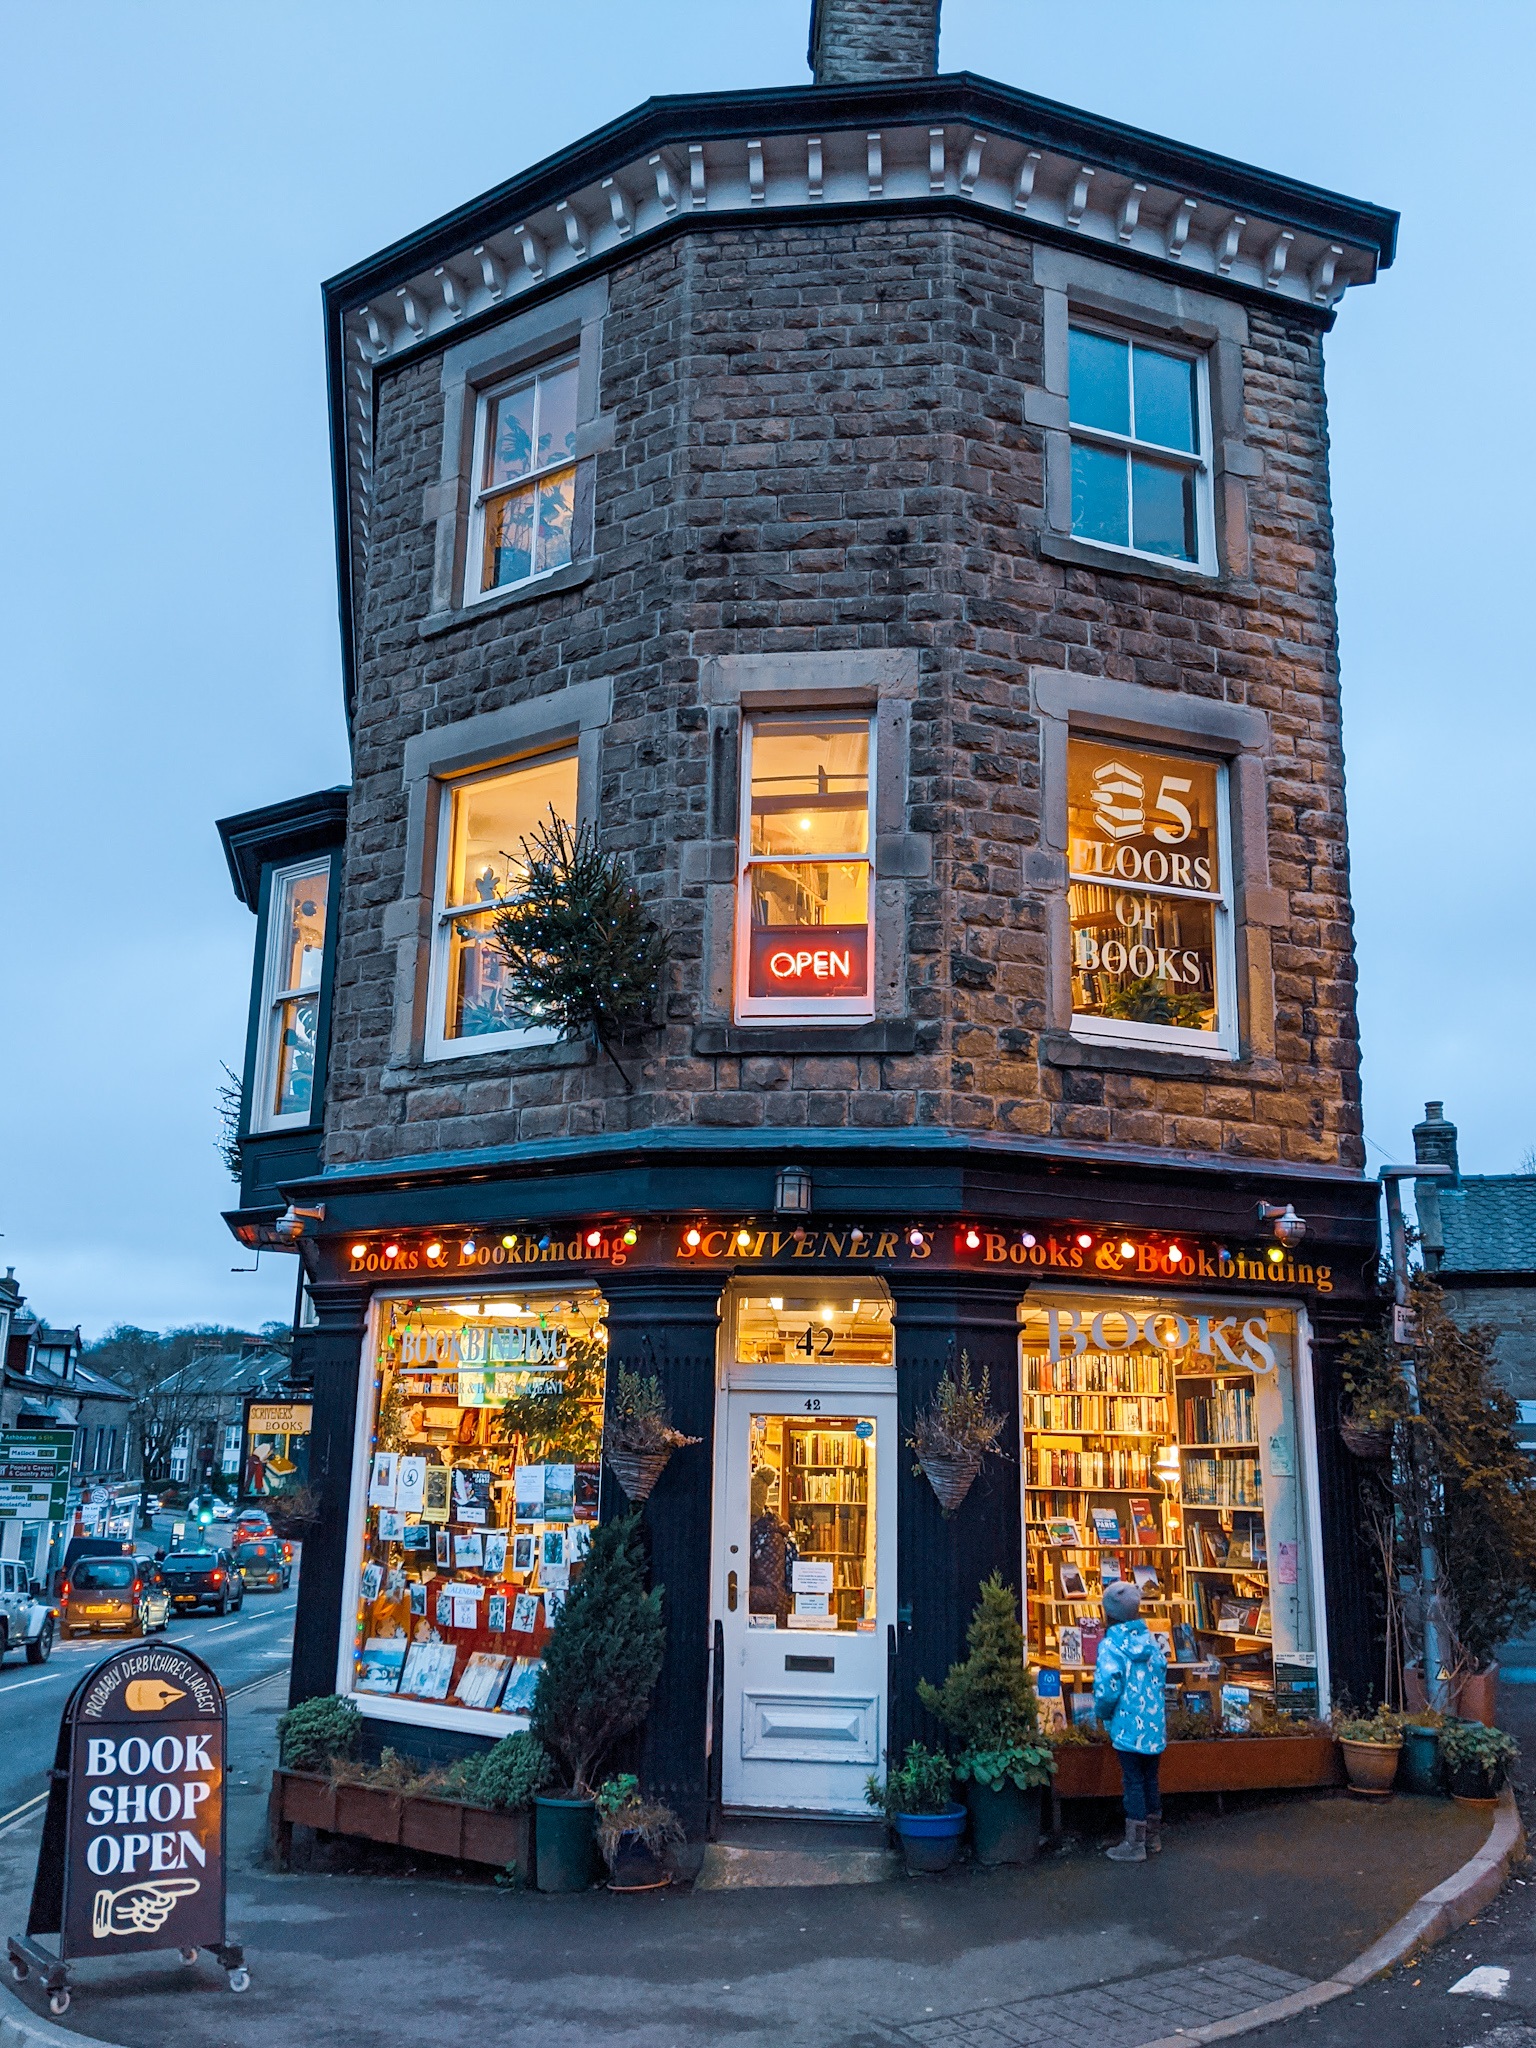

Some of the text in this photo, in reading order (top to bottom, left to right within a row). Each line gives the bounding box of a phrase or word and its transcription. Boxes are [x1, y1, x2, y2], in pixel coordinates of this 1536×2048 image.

[1154, 775, 1193, 844] 5
[1072, 838, 1212, 890] FLOORS
[1115, 893, 1162, 930] OF
[769, 950, 851, 979] OPEN
[1078, 935, 1201, 986] BOOKS
[676, 1229, 935, 1258] SCRIVENER'S
[983, 1232, 1335, 1294] Books & Bookbinding
[400, 1325, 568, 1364] BOOKBINDING
[795, 1327, 836, 1357] 42
[1041, 1306, 1276, 1375] BOOKS
[803, 1398, 821, 1411] 42
[265, 1421, 303, 1431] BOOKS
[1096, 1521, 1117, 1529] PARIS
[446, 1586, 483, 1596] CALENDARS
[84, 1654, 217, 1718] PROBABLY DERBYSHIRE'S LARGEST
[85, 1734, 216, 1777] BOOK
[86, 1781, 212, 1827] SHOP
[87, 1831, 207, 1877] OPEN
